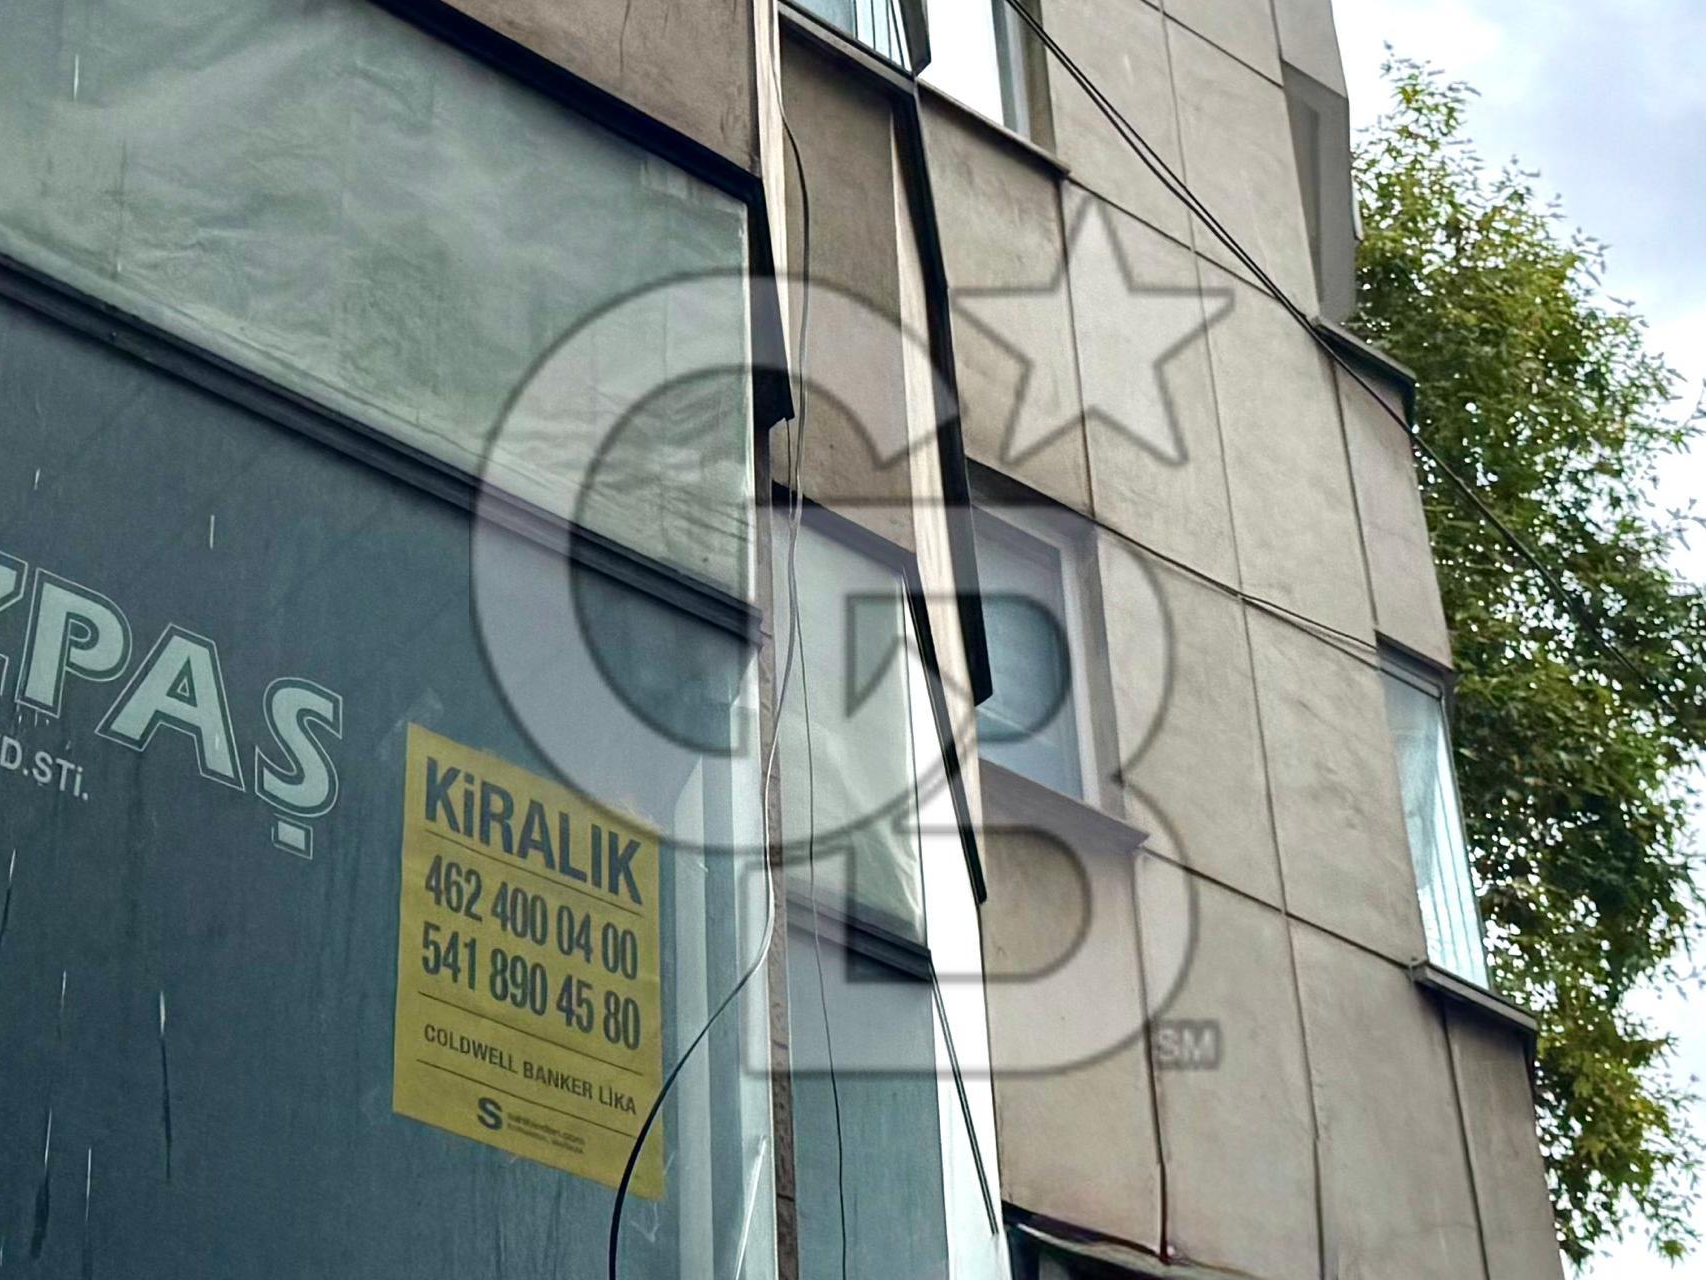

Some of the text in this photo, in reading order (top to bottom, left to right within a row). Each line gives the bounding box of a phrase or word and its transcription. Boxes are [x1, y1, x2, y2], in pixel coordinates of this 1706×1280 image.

[424, 853, 638, 981] 462 400 04 00
[421, 921, 641, 1051] 541 890 45 80
[423, 1023, 519, 1075] COLDWELL
[522, 1060, 593, 1101] BANKER
